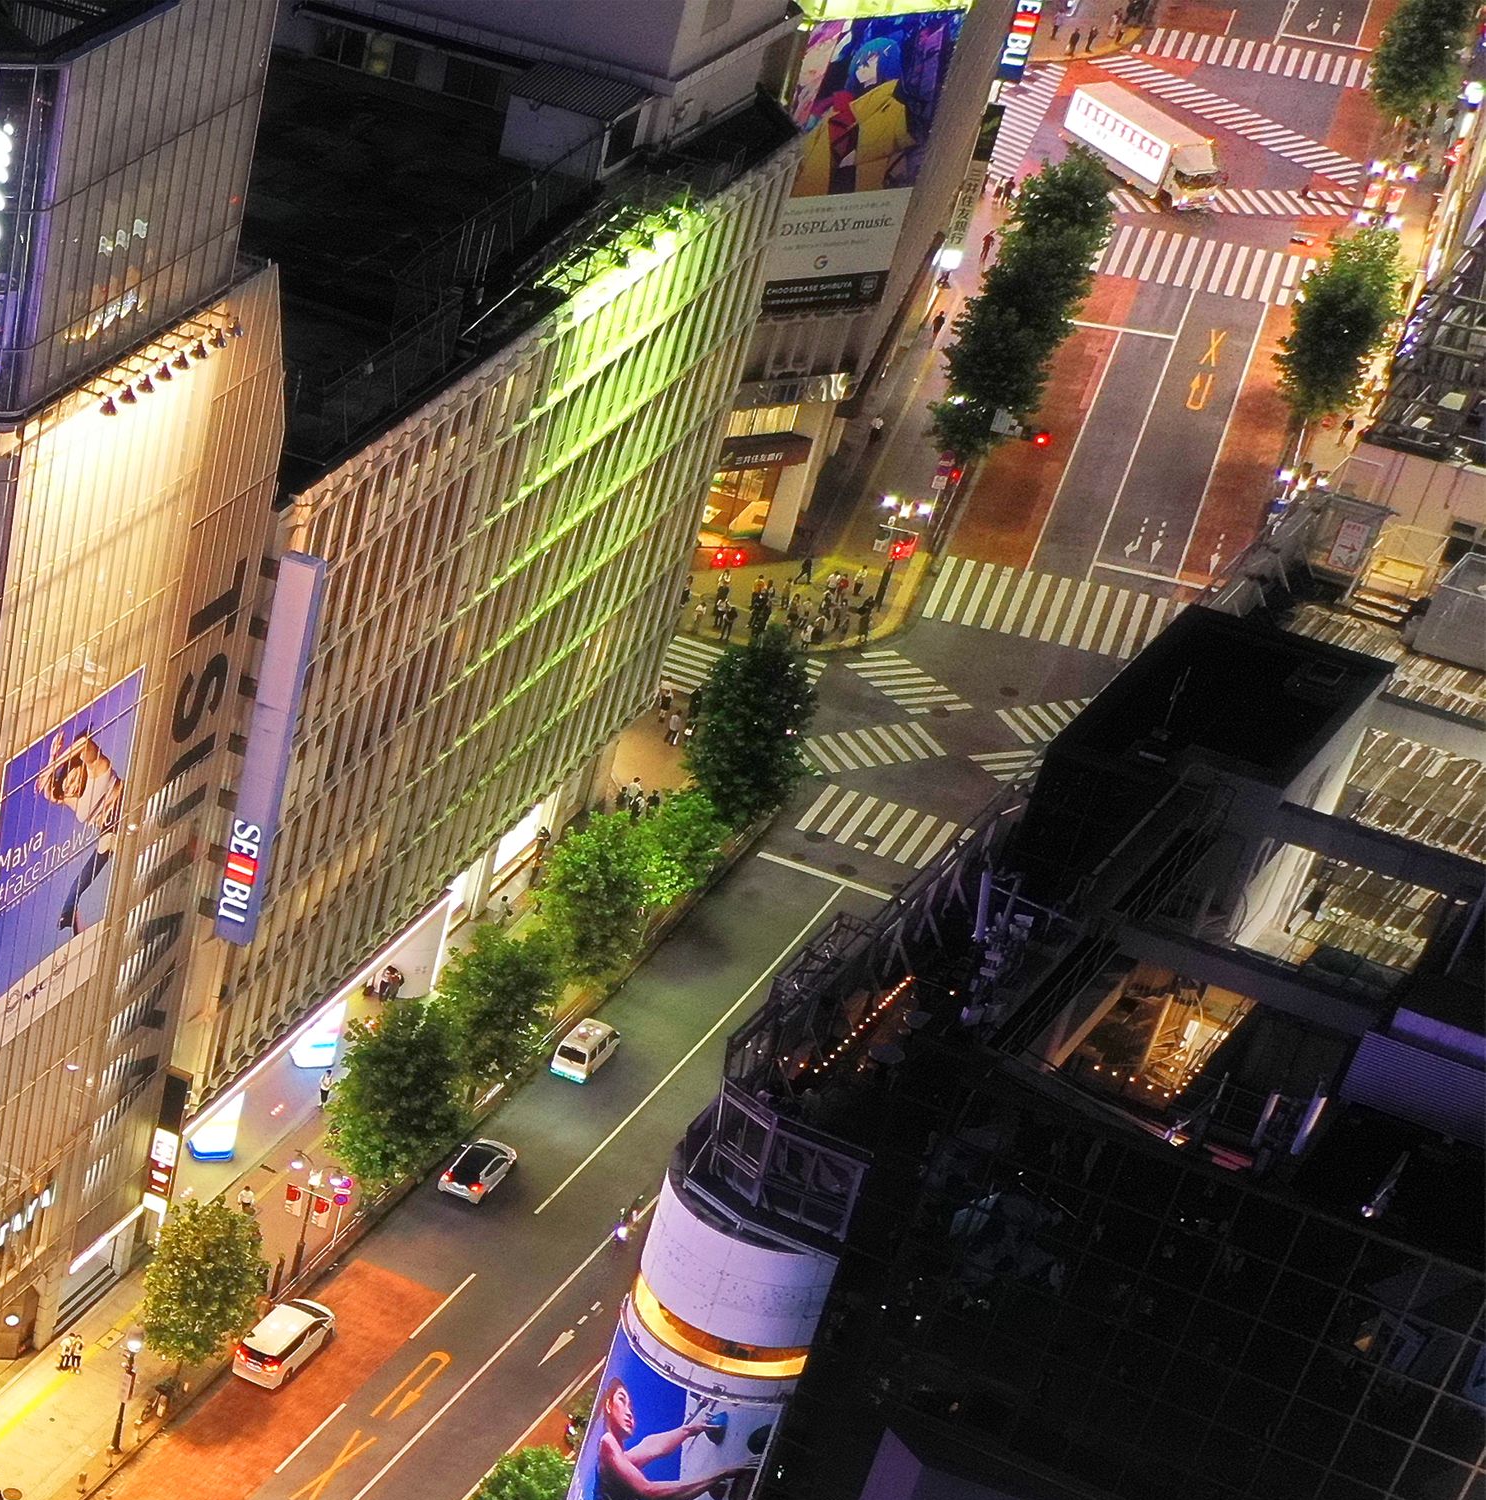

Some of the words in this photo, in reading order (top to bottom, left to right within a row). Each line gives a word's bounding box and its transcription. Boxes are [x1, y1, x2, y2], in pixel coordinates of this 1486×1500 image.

[780, 217, 851, 237] DISPLAY
[766, 285, 818, 296] CHOOSEBASE
[820, 280, 853, 291] SHIBUYA
[735, 448, 784, 467] 三井住友銀行
[218, 819, 261, 925] SEIBU
[24, 982, 46, 1003] NEC
